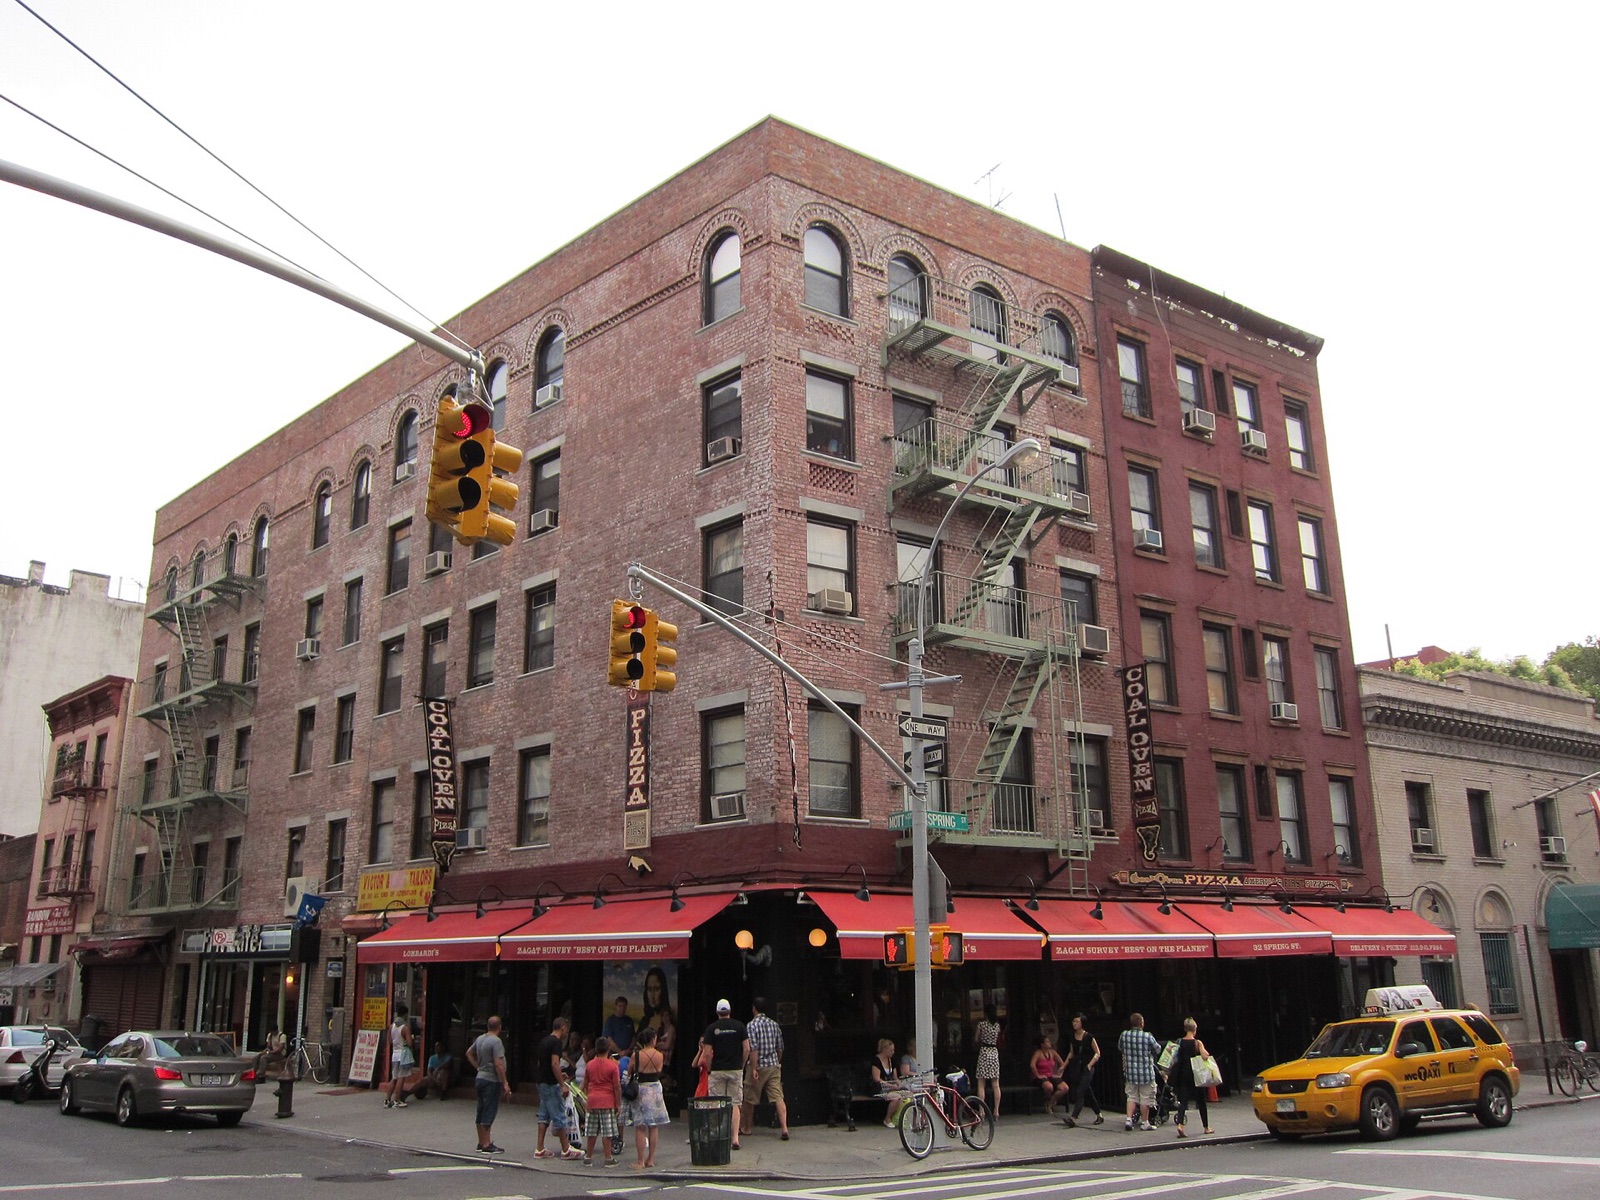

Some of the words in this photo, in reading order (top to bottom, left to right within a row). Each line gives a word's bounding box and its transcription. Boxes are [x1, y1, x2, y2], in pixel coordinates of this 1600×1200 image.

[1126, 667, 1147, 727] COAL
[428, 701, 450, 752] COAL
[905, 722, 918, 732] ONE
[927, 726, 941, 735] WAY
[626, 708, 647, 807] PIZZA
[927, 752, 938, 761] WAY
[1130, 732, 1152, 793] OVEN
[432, 755, 456, 810] OVEN
[1135, 800, 1157, 819] PIZZA
[434, 818, 457, 834] PIZZA
[889, 814, 904, 829] MOTT
[927, 813, 956, 828] SPRING
[363, 874, 384, 890] VICTOR
[410, 869, 433, 886] TAILORS
[1184, 874, 1243, 886] PIZZA
[1284, 878, 1304, 888] FIRST
[403, 949, 440, 957] LOMBARDI'S
[542, 946, 572, 954] SURVEY
[573, 946, 597, 954] "BEST
[598, 945, 609, 954] ON
[610, 945, 628, 953] THE
[629, 944, 668, 953] PLANET"
[1086, 946, 1119, 954] SURVEY
[1159, 945, 1175, 953] THE
[1404, 1073, 1418, 1081] NYC
[1418, 1066, 1441, 1081] TAXI
